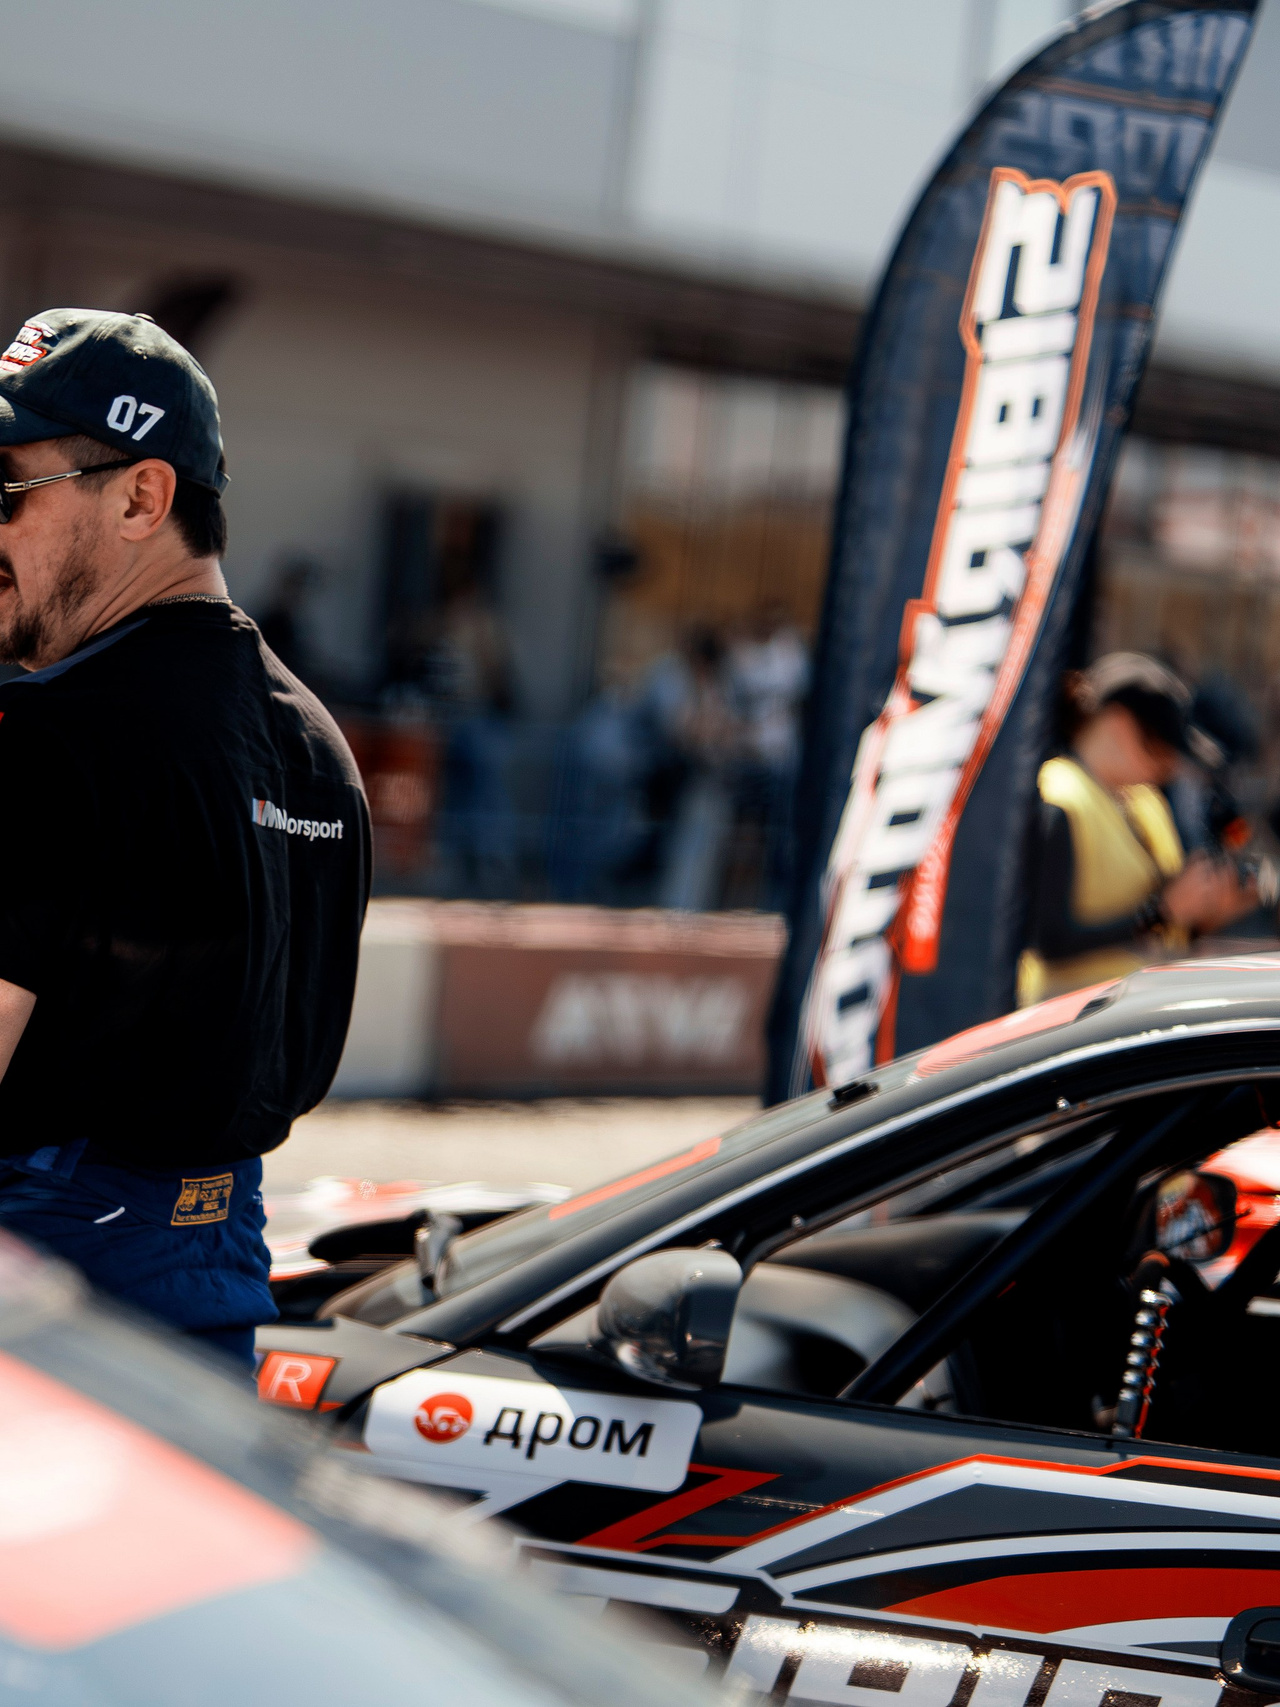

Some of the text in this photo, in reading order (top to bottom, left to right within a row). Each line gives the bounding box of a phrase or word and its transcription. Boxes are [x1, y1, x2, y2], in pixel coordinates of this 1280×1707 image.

[106, 395, 166, 440] 07
[267, 1357, 313, 1402] R
[483, 1406, 655, 1459] дром
